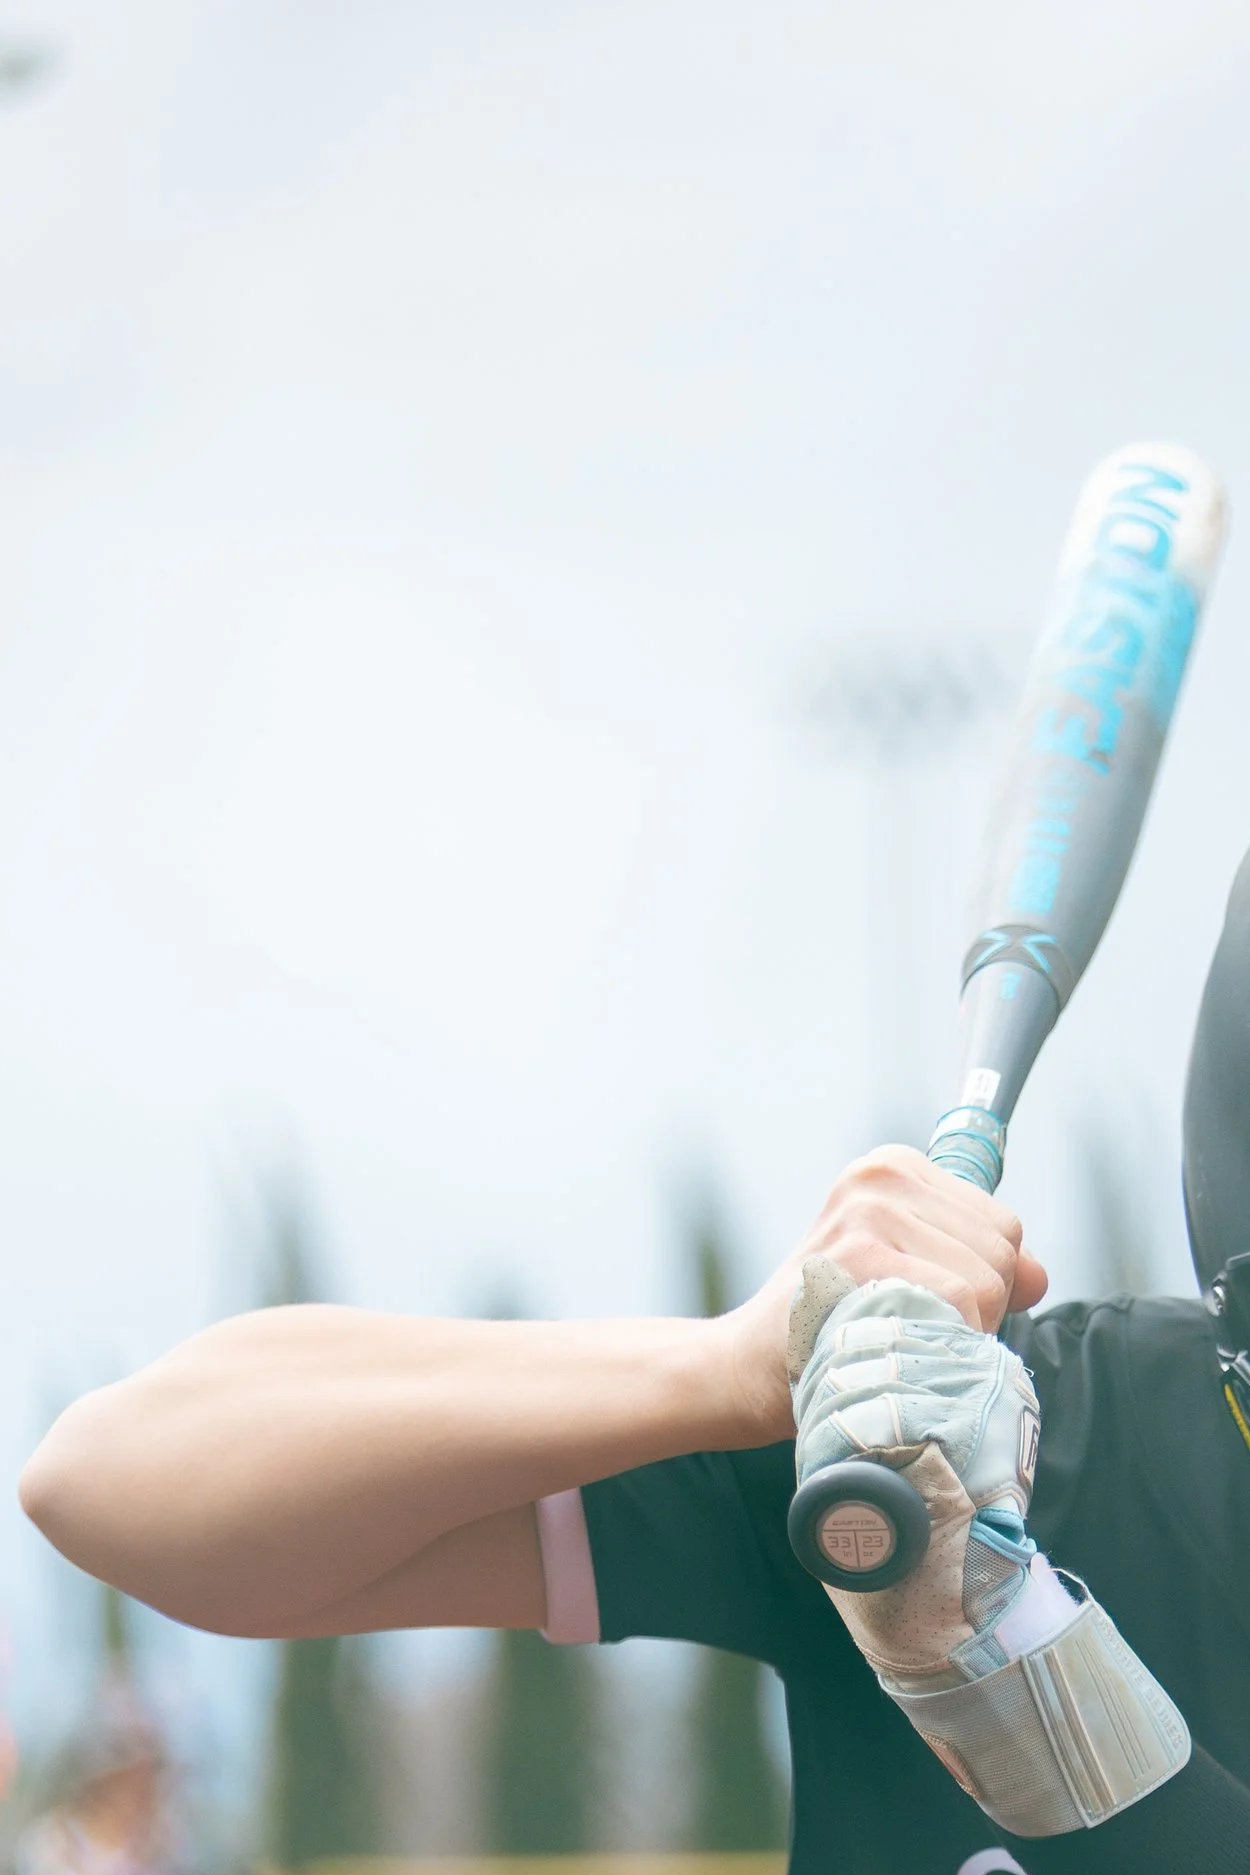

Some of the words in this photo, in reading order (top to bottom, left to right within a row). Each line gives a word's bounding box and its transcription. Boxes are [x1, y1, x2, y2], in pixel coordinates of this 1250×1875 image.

[1033, 460, 1192, 776] EASTON
[827, 1535, 852, 1549] 33
[861, 1534, 884, 1549] 23
